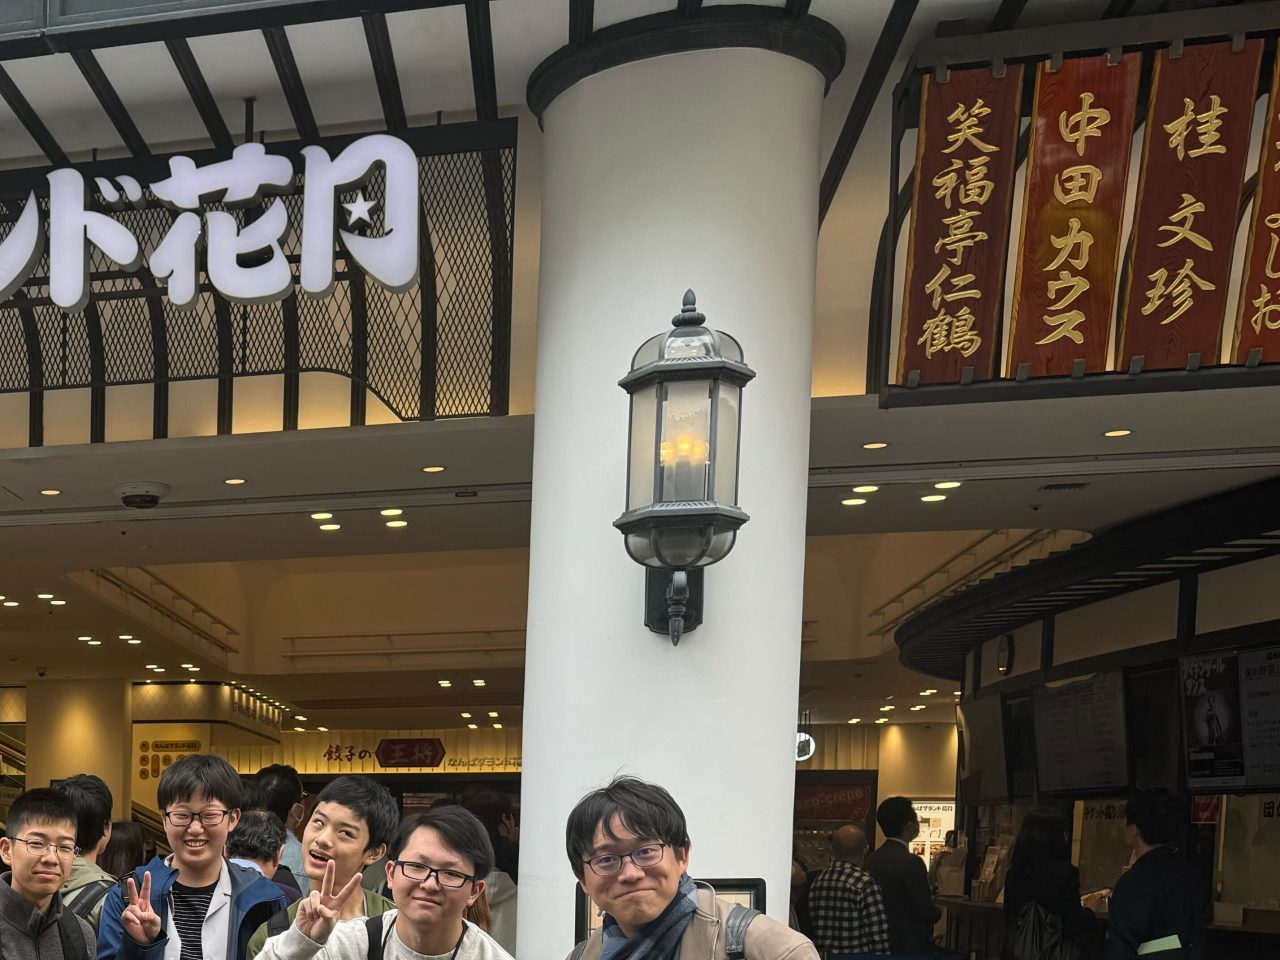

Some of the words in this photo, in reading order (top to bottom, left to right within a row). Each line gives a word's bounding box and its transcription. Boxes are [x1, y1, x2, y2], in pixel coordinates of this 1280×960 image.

[917, 98, 1000, 359] 笑福亭仁鶴
[1035, 92, 1111, 345] 中田カウス
[323, 744, 372, 763] 餃子の
[390, 744, 433, 764] 王将
